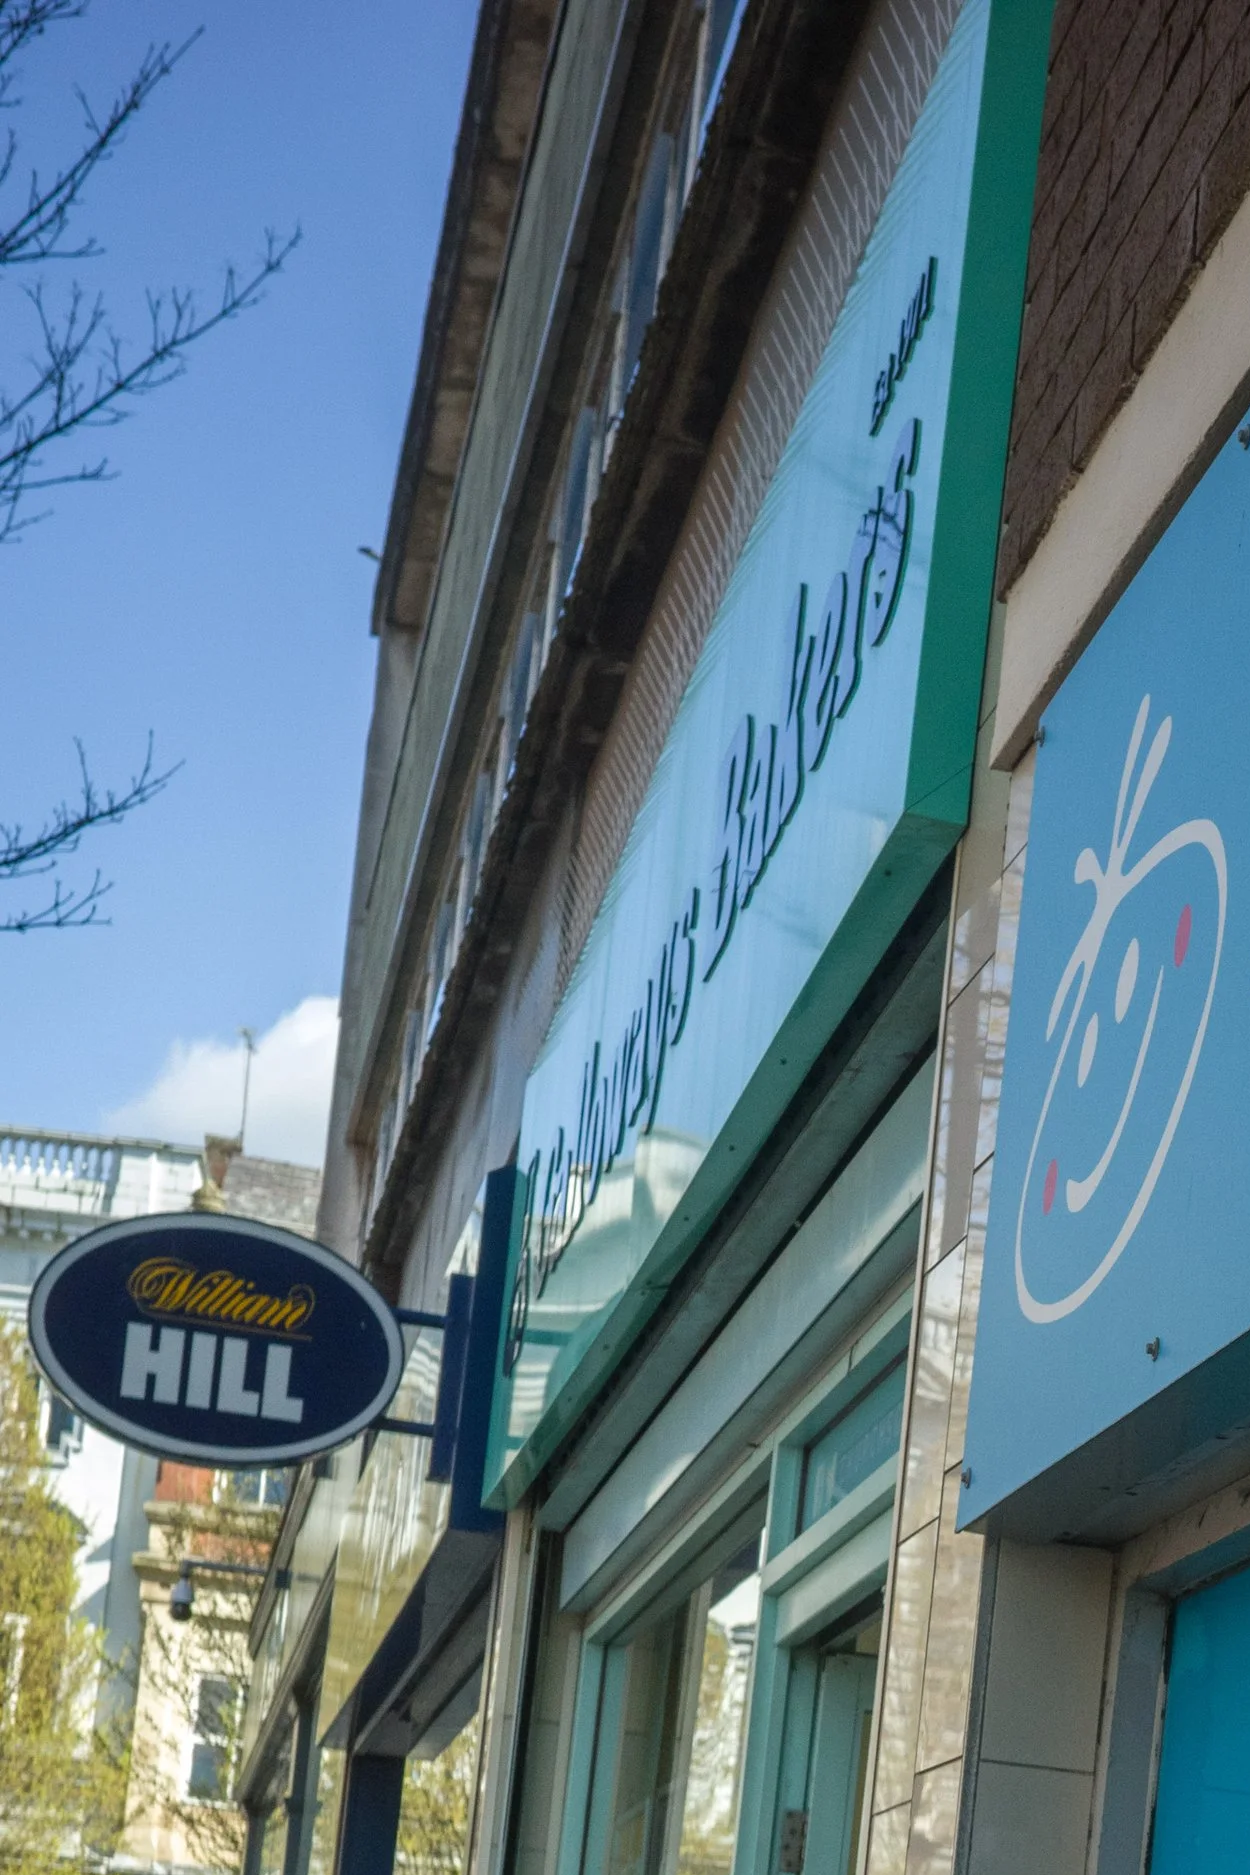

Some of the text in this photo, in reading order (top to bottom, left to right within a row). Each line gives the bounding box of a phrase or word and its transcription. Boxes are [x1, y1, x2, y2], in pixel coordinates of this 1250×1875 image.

[702, 417, 923, 983] Bakers
[126, 1256, 316, 1330] William
[119, 1321, 304, 1424] HILL
